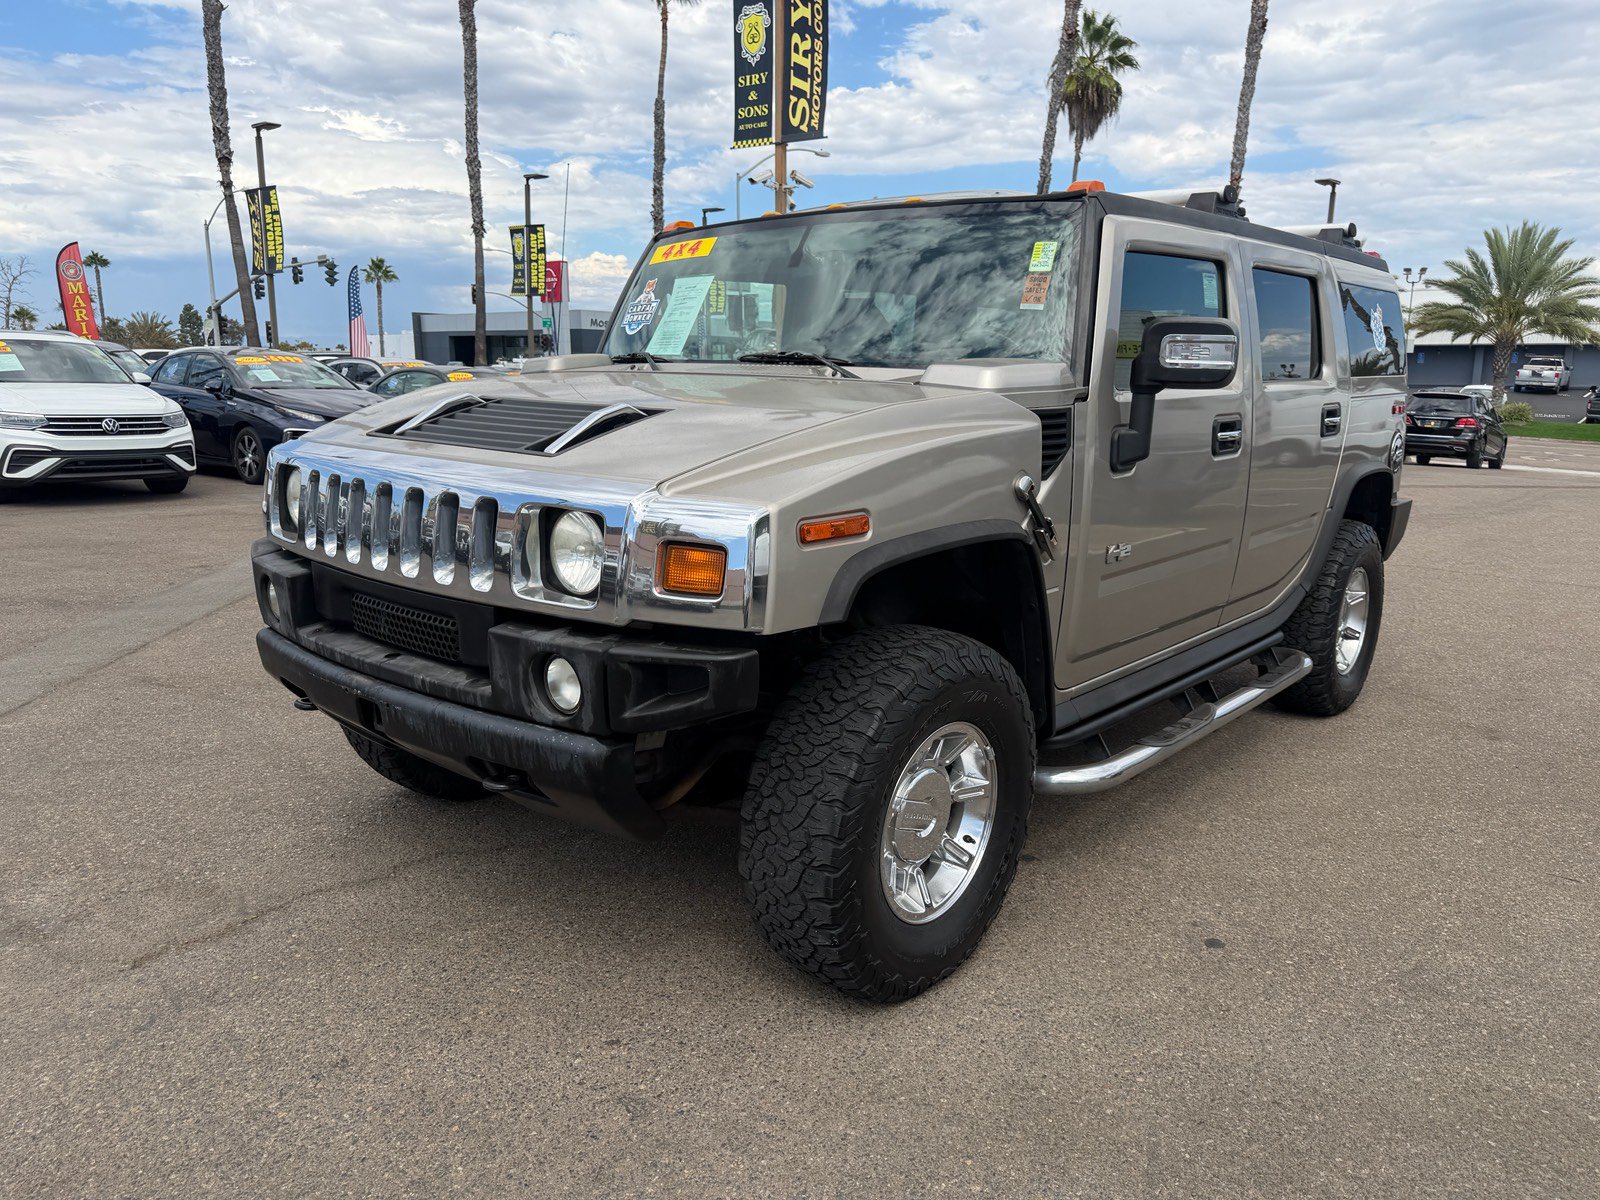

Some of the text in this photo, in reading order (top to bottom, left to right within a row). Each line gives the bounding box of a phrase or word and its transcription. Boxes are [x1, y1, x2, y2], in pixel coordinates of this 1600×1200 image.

[738, 72, 769, 87] SIRY
[789, 0, 812, 133] SIRY
[811, 0, 823, 131] MOTORS.CO
[737, 104, 769, 119] SONS
[748, 91, 758, 101] &
[264, 204, 276, 257] ANYONE
[269, 189, 283, 271] WE FINANCE
[530, 233, 538, 288] AUTO CARE
[537, 227, 546, 294] FULL SERVICE
